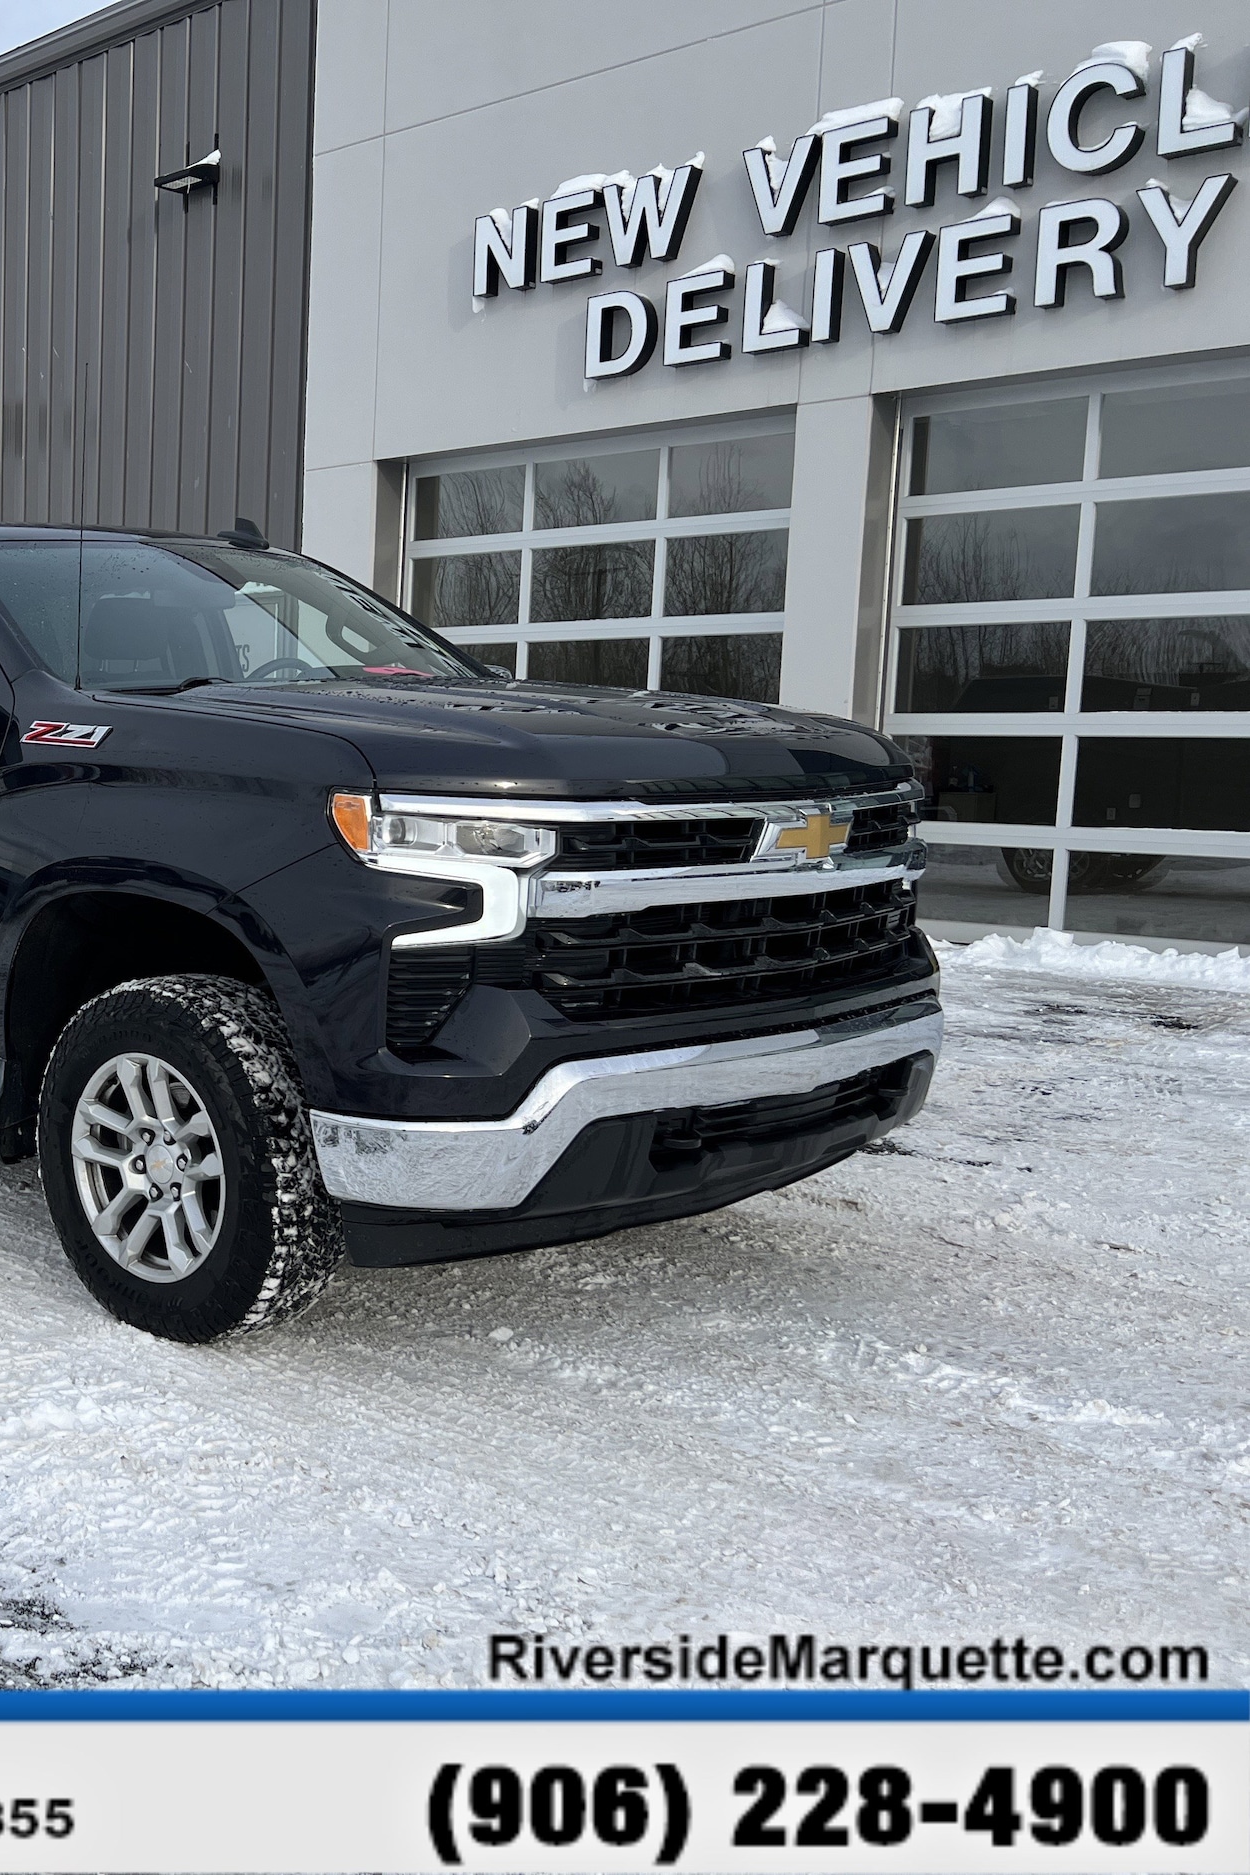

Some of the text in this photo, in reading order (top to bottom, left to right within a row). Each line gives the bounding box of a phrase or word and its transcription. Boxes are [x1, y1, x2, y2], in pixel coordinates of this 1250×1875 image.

[472, 47, 1250, 298] NEW VEHICL
[584, 173, 1239, 381] DELIVERY
[18, 718, 114, 749] Z71
